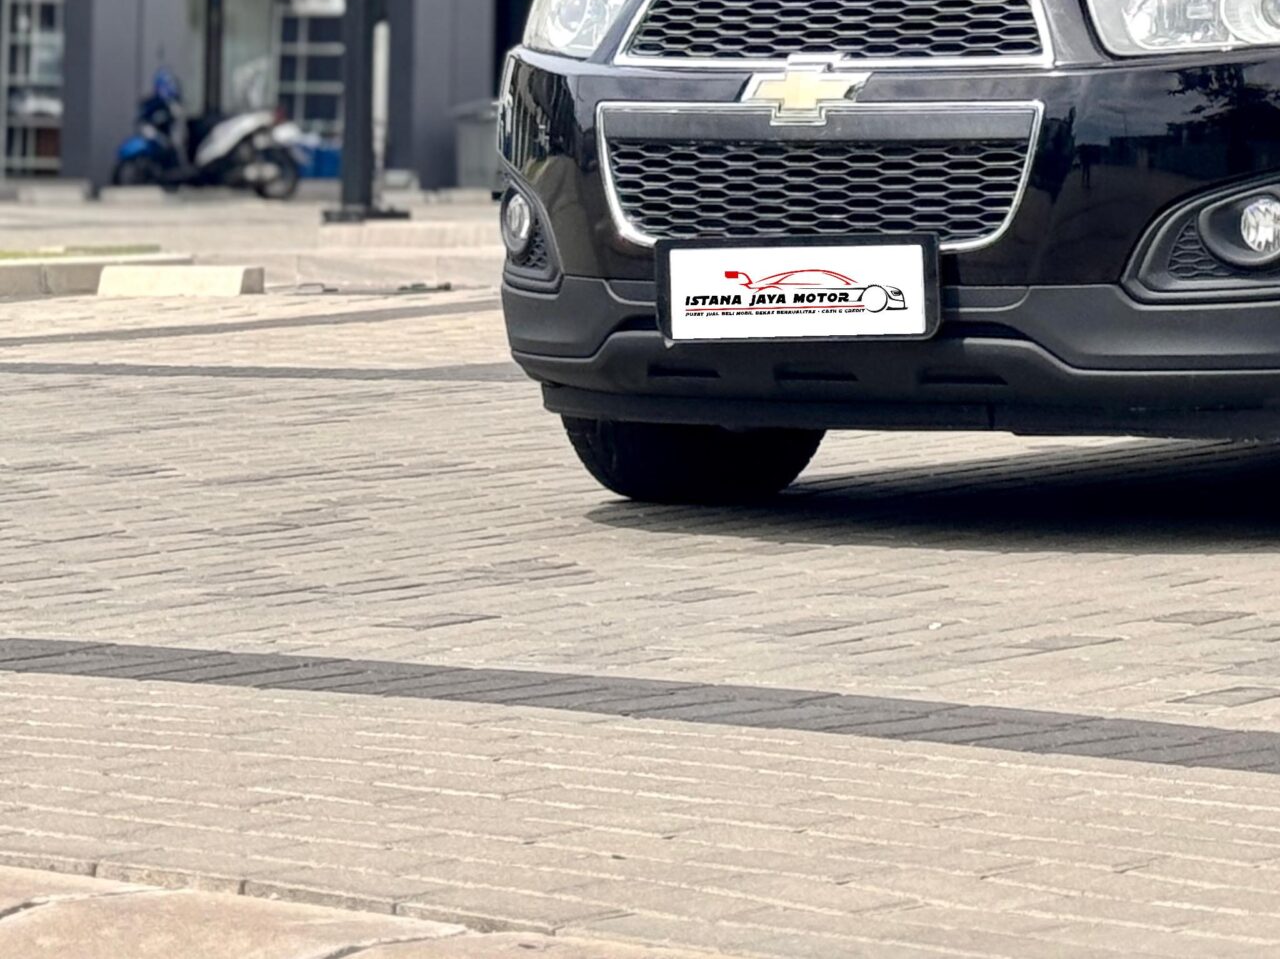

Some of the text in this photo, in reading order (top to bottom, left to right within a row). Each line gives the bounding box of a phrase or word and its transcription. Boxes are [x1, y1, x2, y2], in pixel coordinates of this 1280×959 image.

[685, 292, 849, 306] ISTANA JAYA MOTOR
